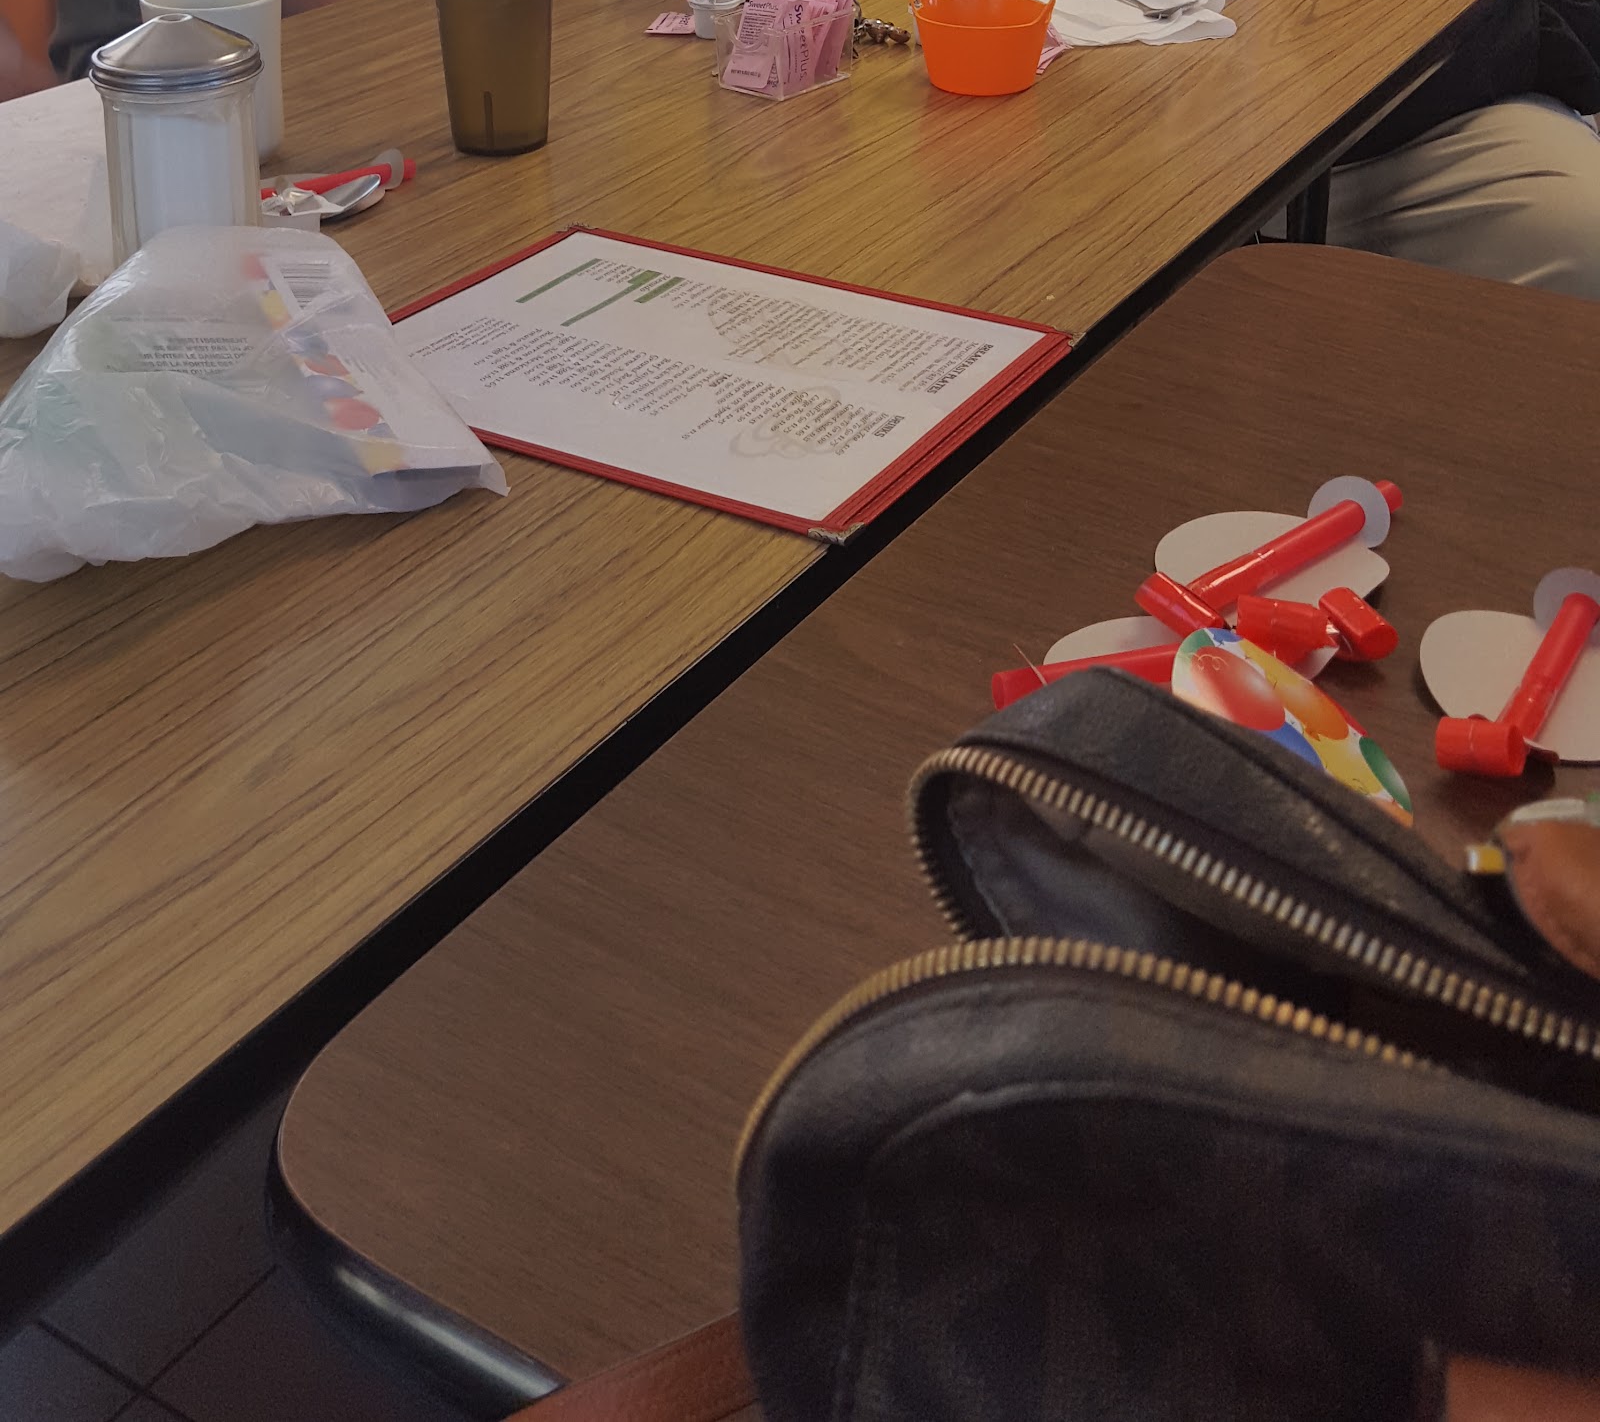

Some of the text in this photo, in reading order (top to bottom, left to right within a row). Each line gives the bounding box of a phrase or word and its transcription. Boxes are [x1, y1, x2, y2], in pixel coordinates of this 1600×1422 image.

[950, 344, 993, 374] BREAKFAST
[927, 374, 957, 394] PLATES
[874, 416, 904, 437] DRINKS
